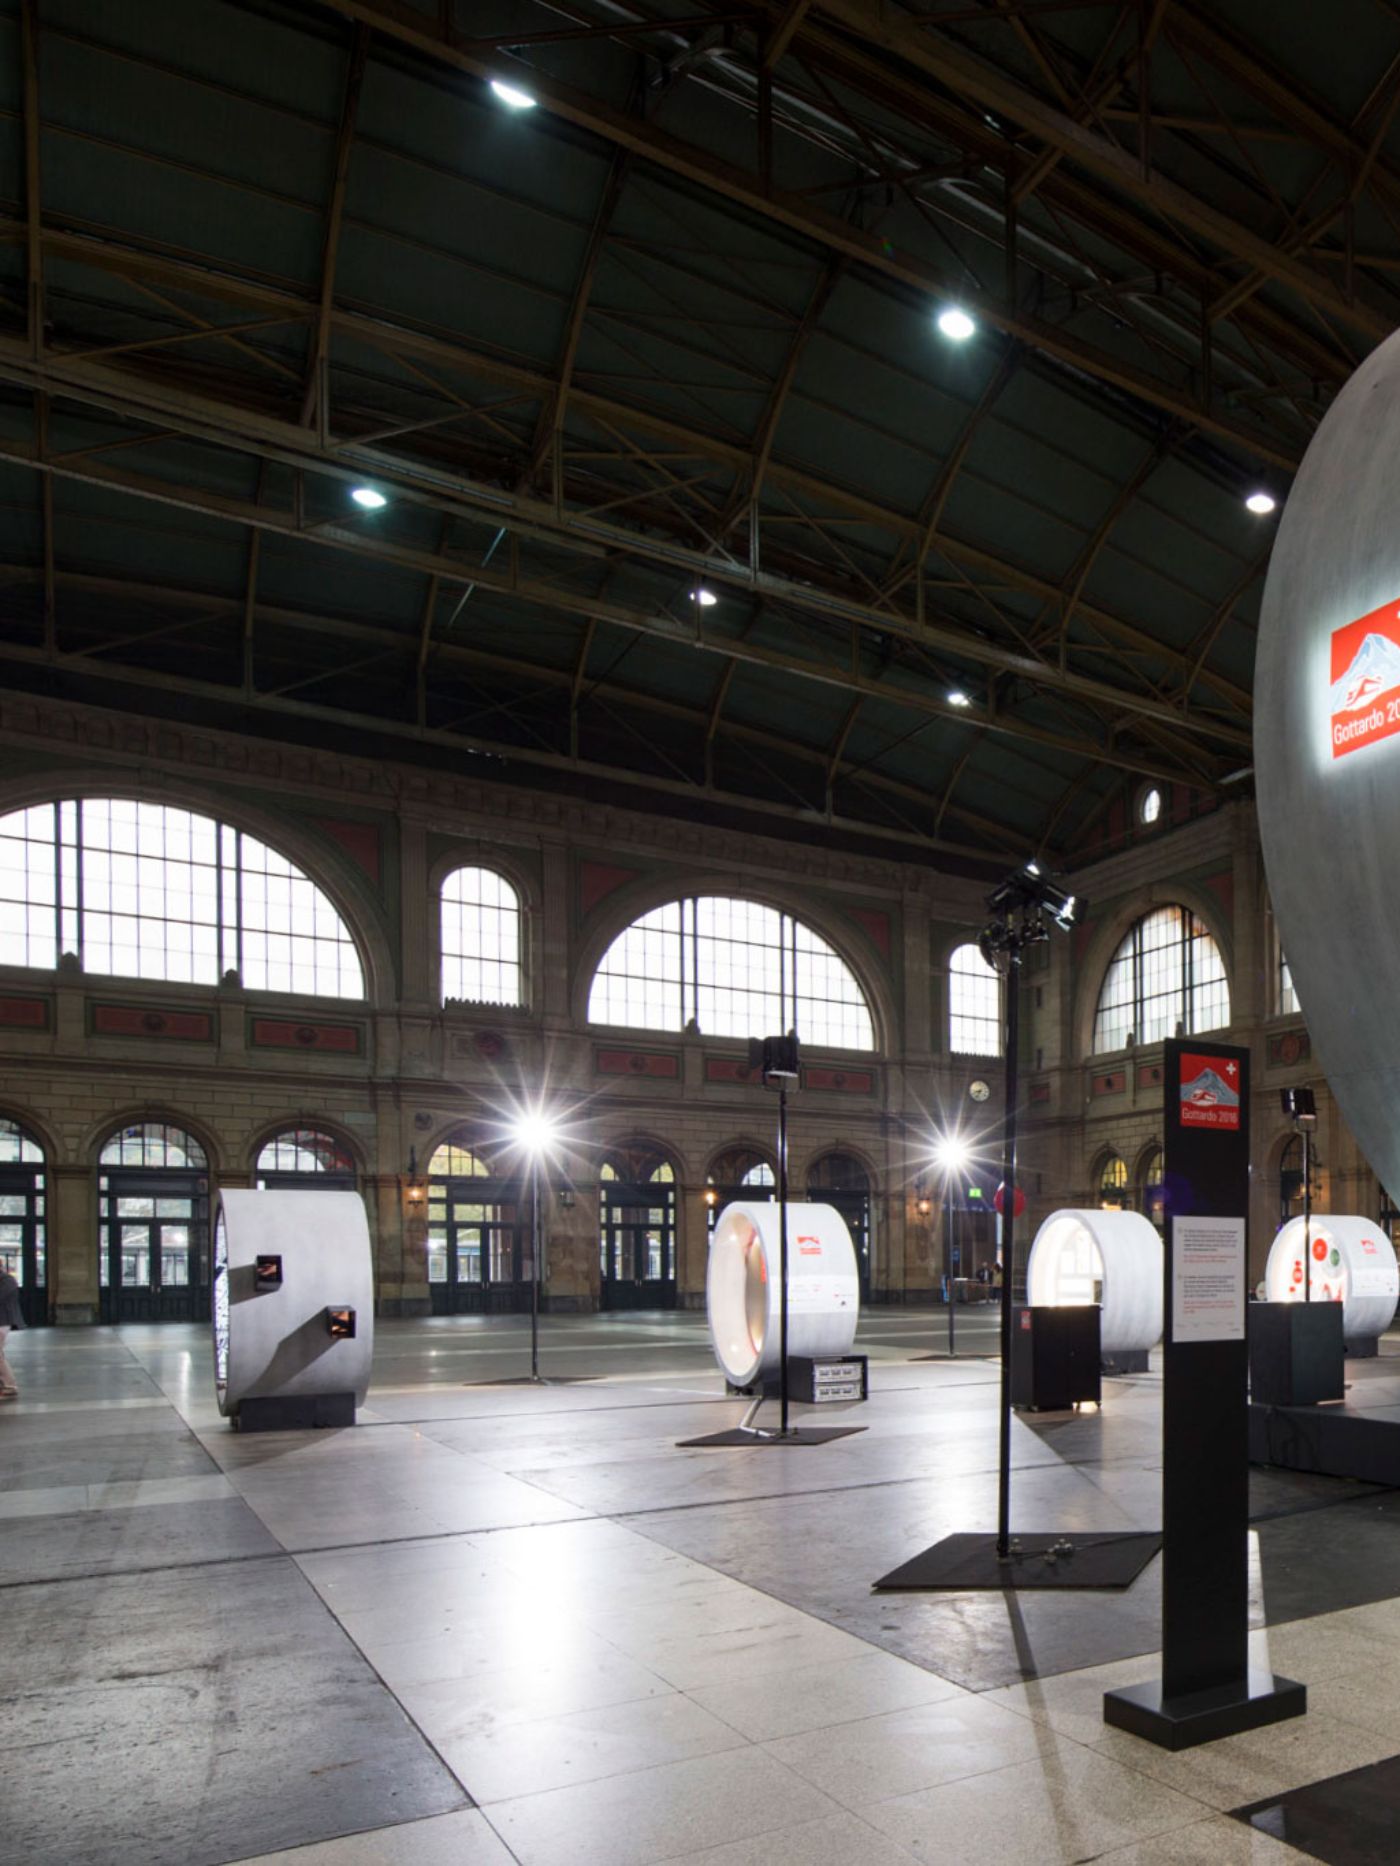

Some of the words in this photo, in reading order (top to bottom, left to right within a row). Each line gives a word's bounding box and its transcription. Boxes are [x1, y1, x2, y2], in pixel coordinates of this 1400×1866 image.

[1333, 708, 1385, 745] Gottardo
[1181, 1106, 1217, 1122] Gottardo
[1218, 1110, 1238, 1124] 2016
